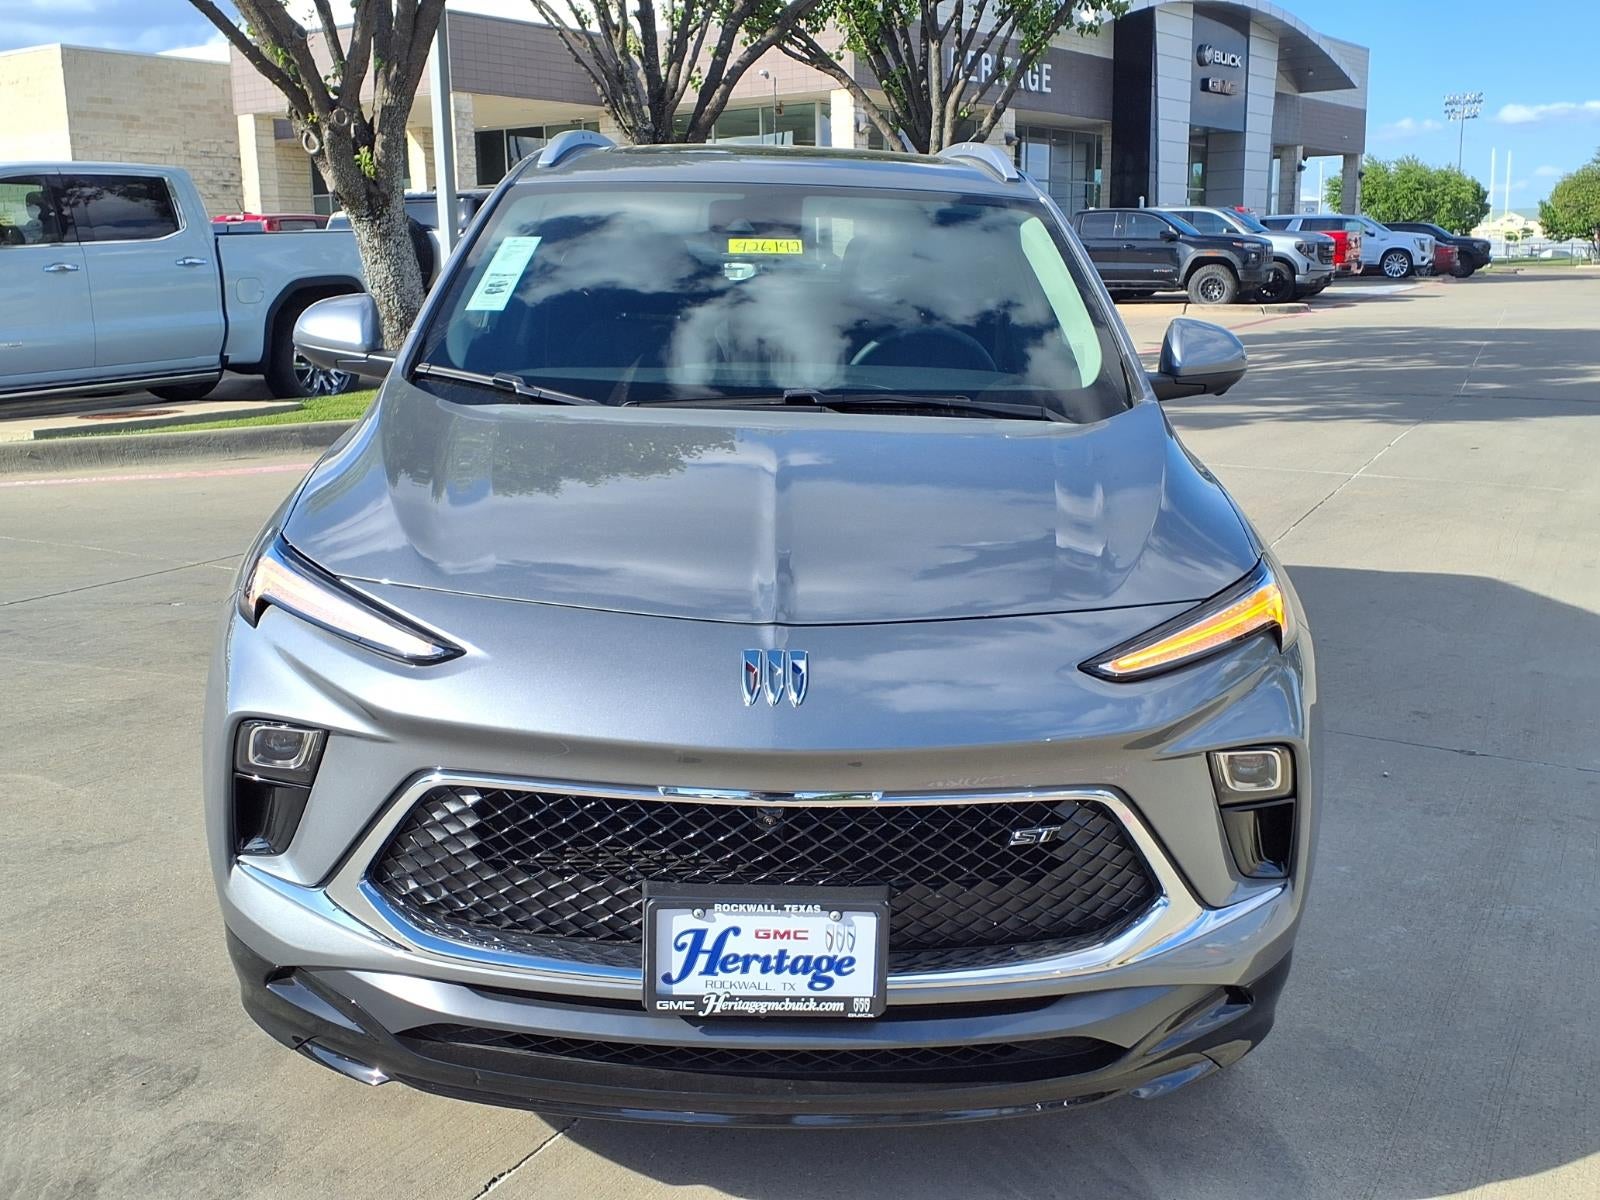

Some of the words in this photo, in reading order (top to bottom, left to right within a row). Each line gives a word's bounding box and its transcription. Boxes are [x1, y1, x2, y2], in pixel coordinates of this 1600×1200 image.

[1214, 50, 1242, 68] BUICK
[1009, 825, 1062, 846] ST
[714, 903, 781, 914] ROCKWALL,
[784, 904, 821, 914] TEXAS
[754, 929, 809, 941] GMC
[661, 925, 856, 992] Heritage
[705, 979, 776, 991] ROCKWALL,
[782, 981, 797, 991] TX
[656, 1000, 695, 1010] GMC
[698, 993, 845, 1016] Heritagegmcbuick.com
